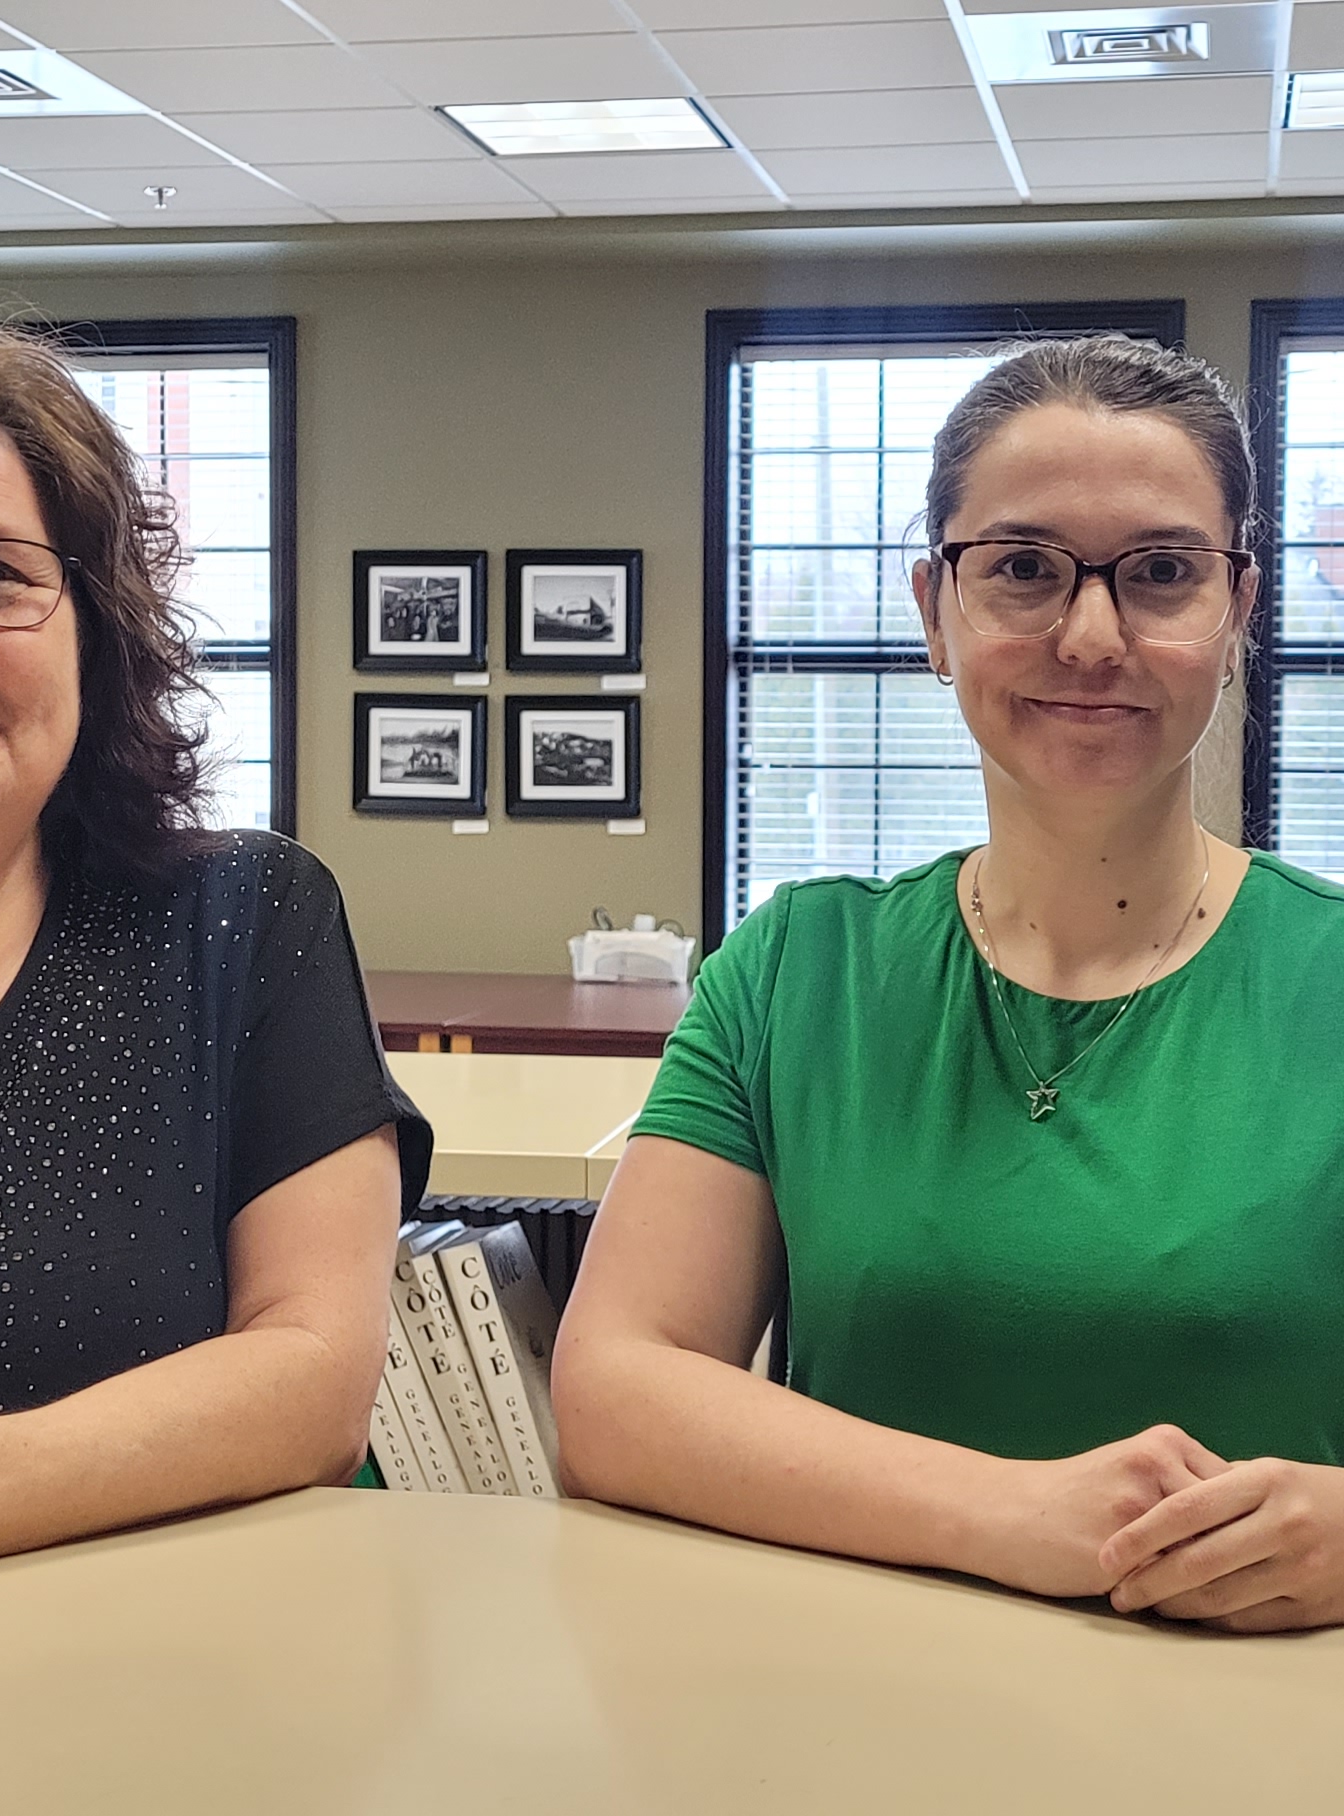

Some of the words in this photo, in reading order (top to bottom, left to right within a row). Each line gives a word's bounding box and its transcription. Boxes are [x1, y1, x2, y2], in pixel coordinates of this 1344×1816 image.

[395, 1260, 451, 1376] CÔTÉ
[422, 1269, 456, 1339] CÔTÉ
[461, 1256, 510, 1376] CÔTÉ
[374, 1401, 413, 1492] NEALOG
[449, 1394, 494, 1492] GENEALO
